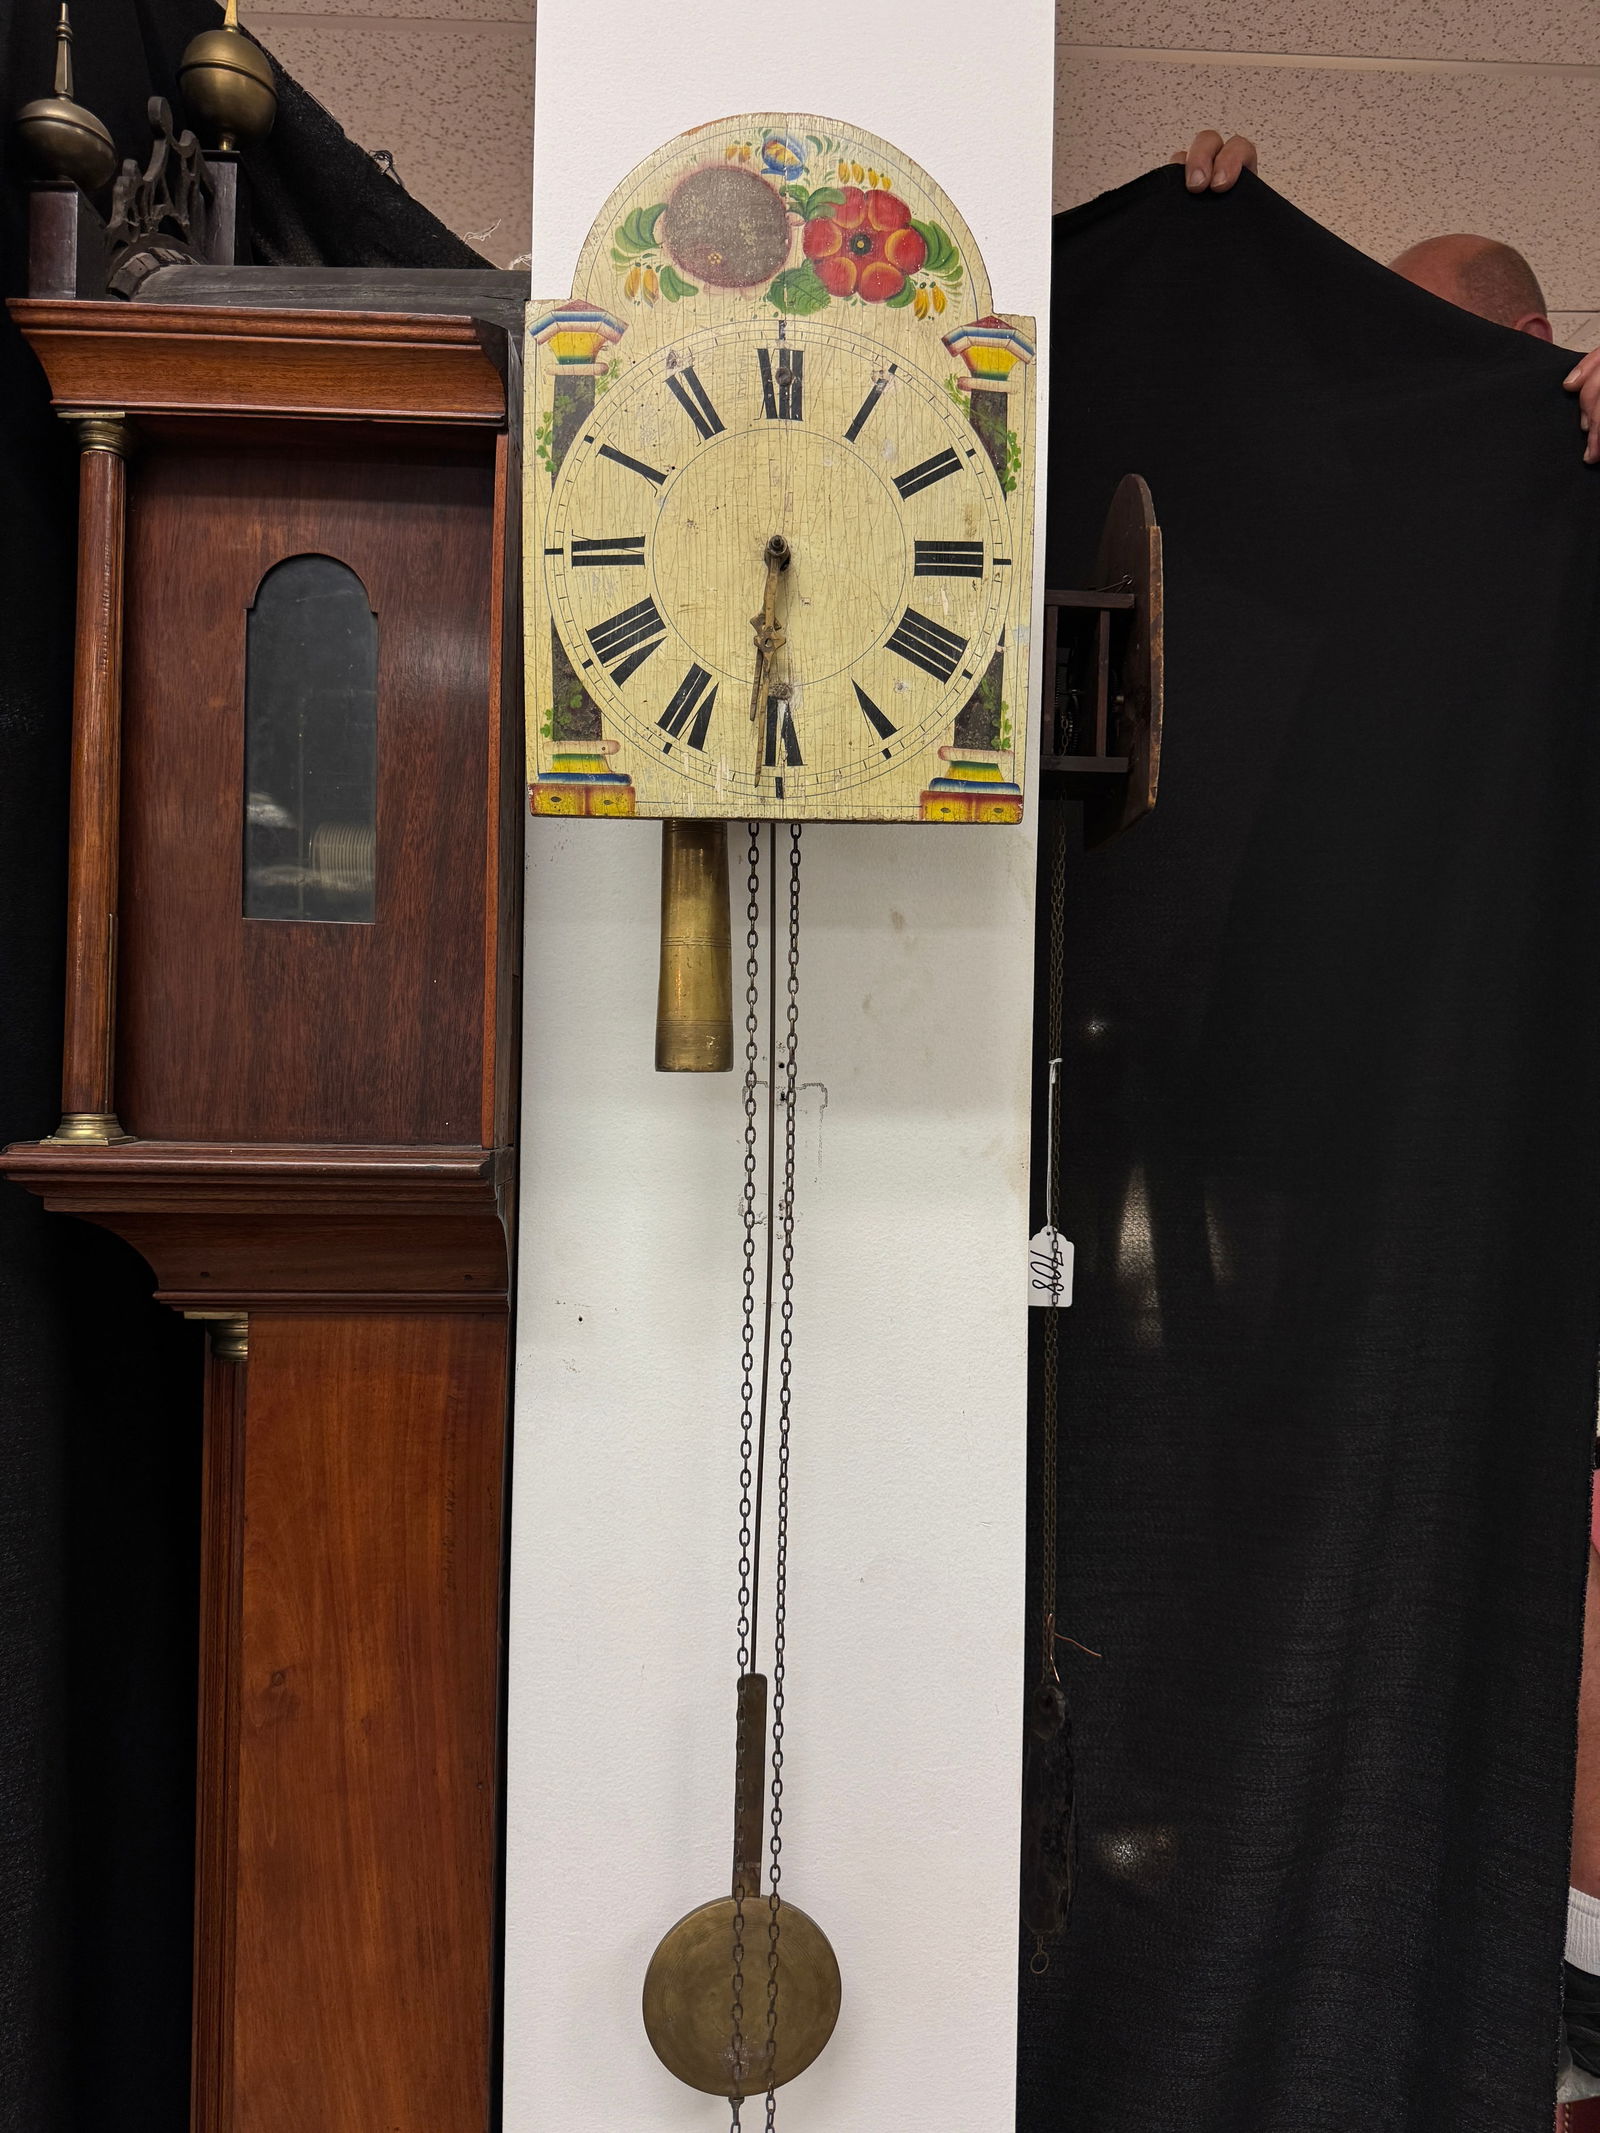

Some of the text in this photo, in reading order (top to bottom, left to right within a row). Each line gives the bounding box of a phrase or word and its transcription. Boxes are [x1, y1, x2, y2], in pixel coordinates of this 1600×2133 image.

[665, 367, 726, 446] XI
[753, 347, 804, 422] XII
[843, 376, 888, 444] I
[891, 446, 964, 502] II
[571, 529, 646, 567] IX
[914, 540, 984, 578] III
[585, 594, 668, 690] VIII
[884, 606, 970, 684] IIII
[655, 663, 719, 753] VII
[764, 696, 808, 767] VI
[851, 679, 902, 748] V
[1029, 1248, 1065, 1296] 708
